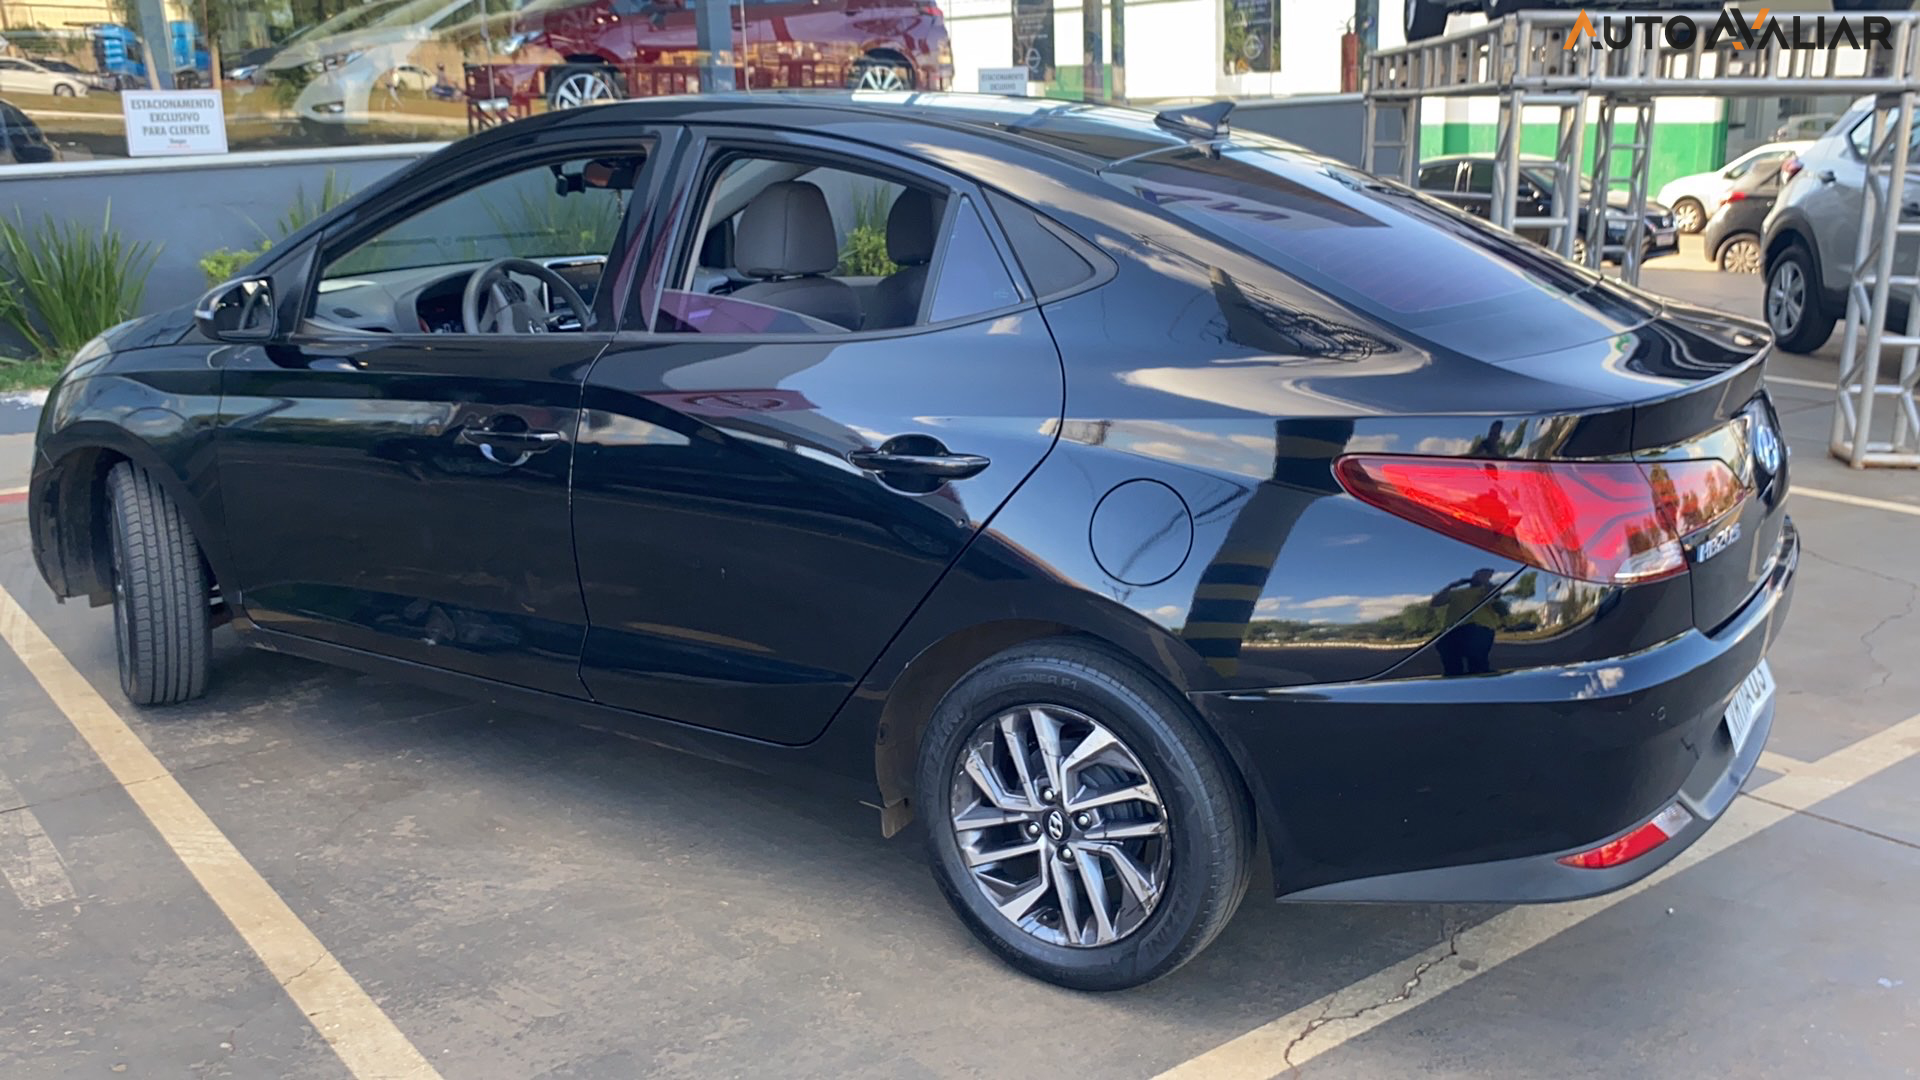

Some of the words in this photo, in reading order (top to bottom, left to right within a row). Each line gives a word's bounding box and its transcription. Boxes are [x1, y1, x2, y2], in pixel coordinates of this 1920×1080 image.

[130, 98, 215, 110] ESTACIONAMENTO
[149, 111, 201, 123] EXCLUSIVO
[142, 125, 168, 137] PARA
[168, 124, 210, 136] CLIENTES
